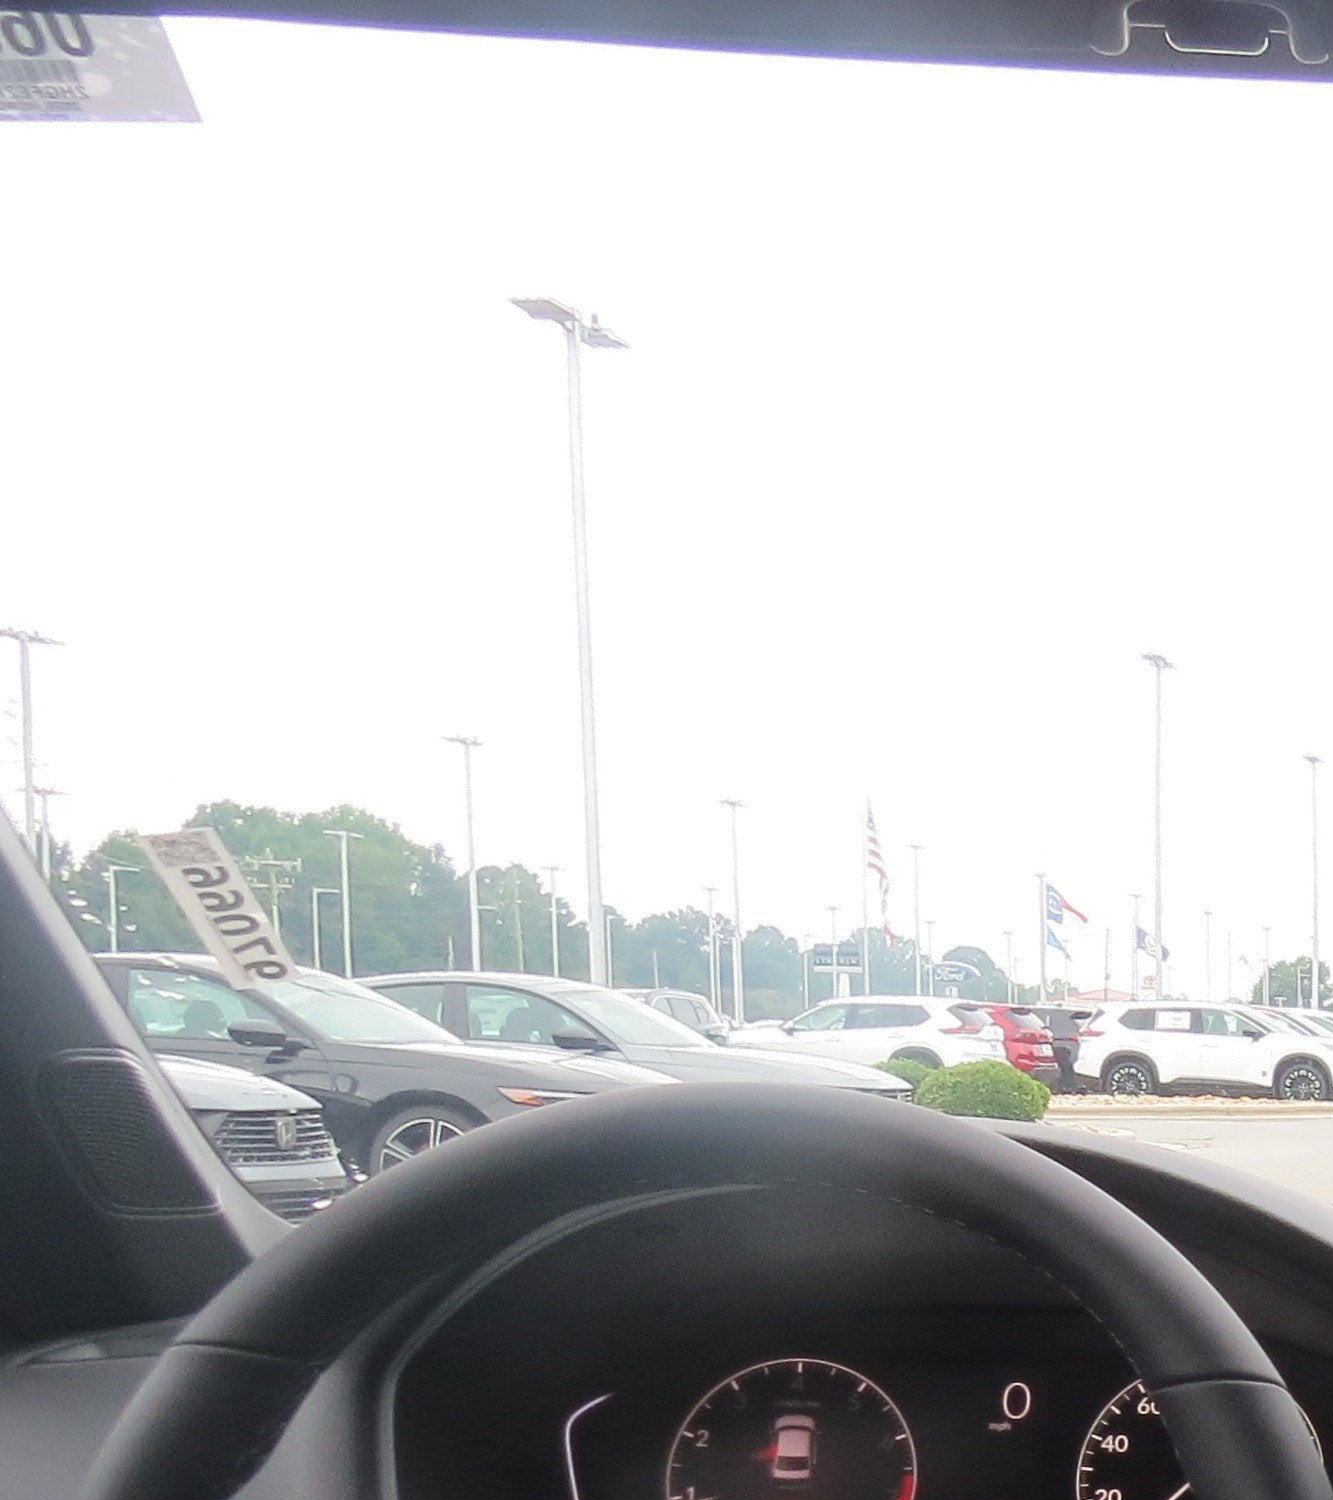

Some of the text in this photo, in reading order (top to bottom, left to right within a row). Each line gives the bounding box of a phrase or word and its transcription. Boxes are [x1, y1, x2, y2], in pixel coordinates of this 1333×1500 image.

[1002, 1382, 1032, 1420] 0
[694, 1429, 709, 1448] 2
[1100, 1434, 1130, 1453] 40
